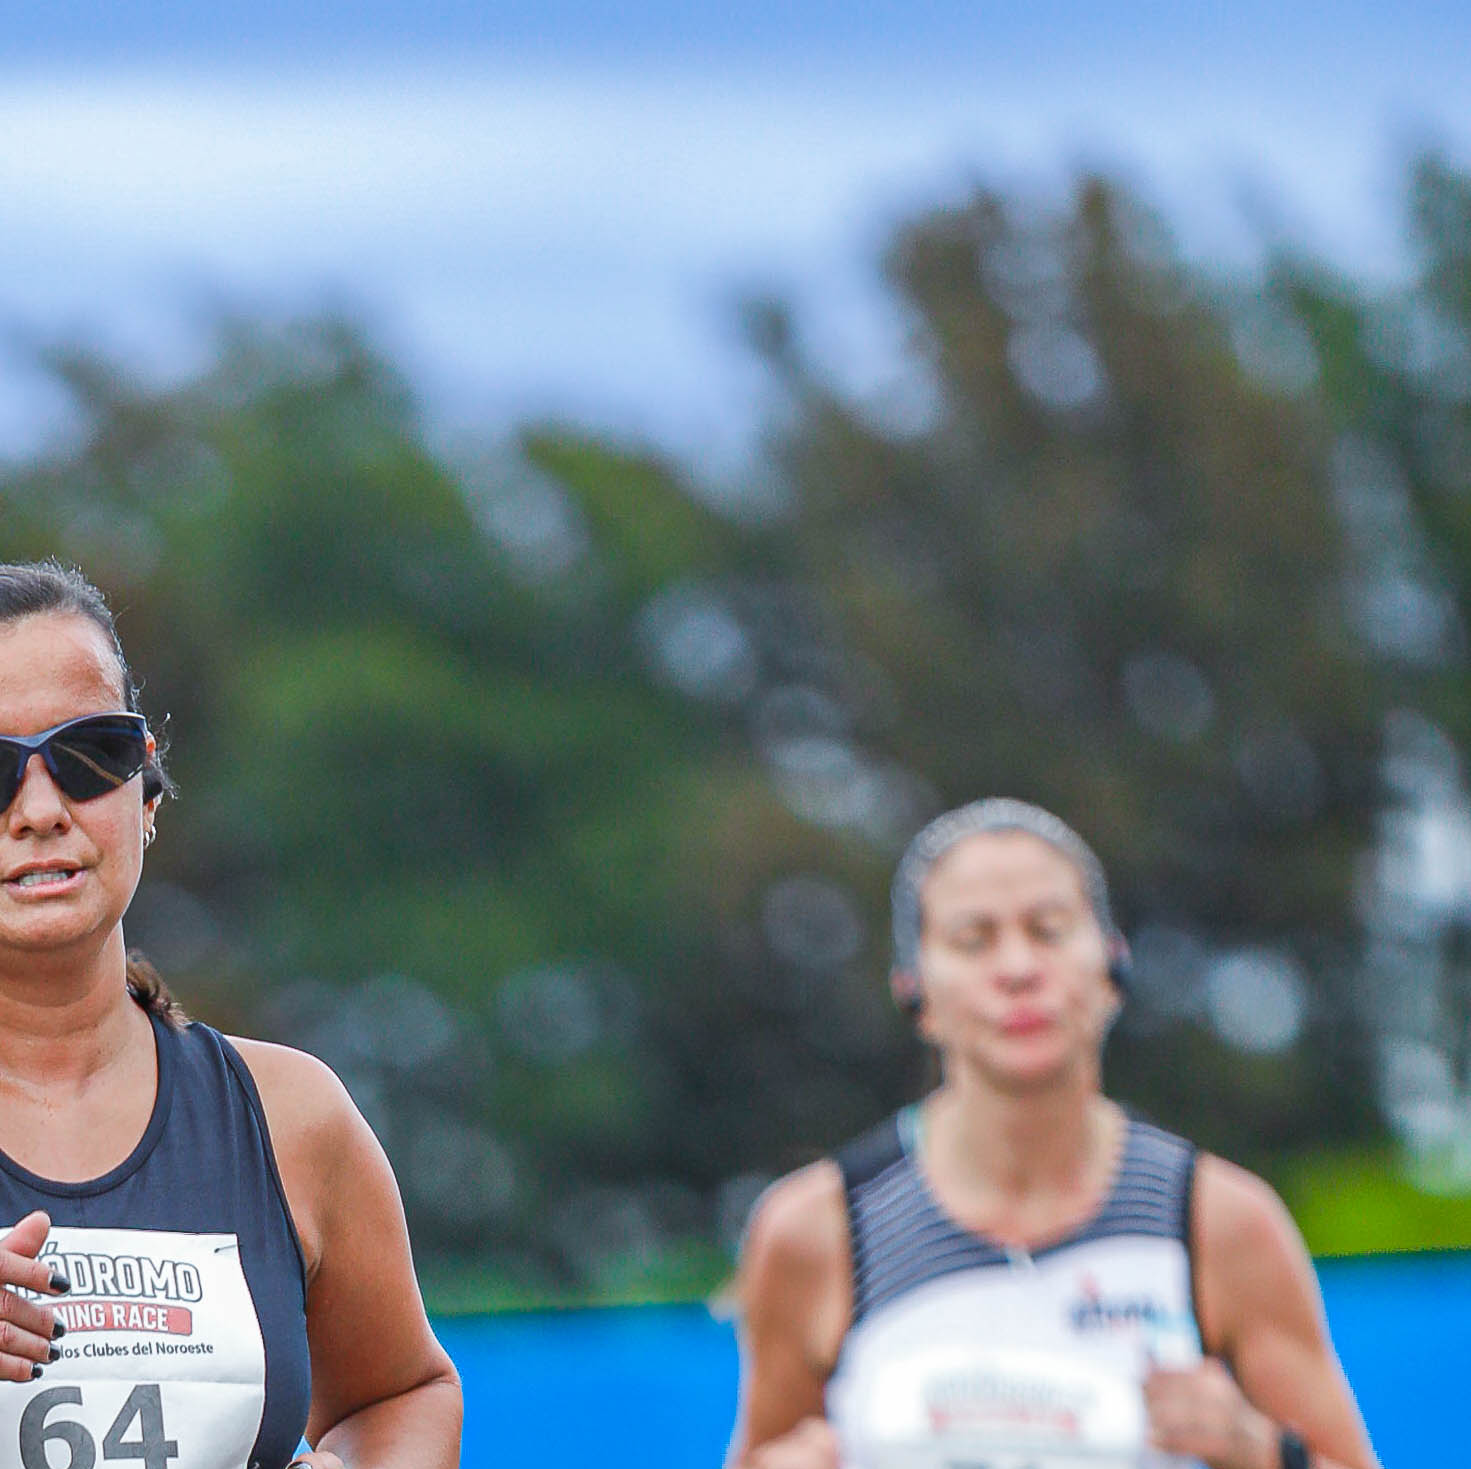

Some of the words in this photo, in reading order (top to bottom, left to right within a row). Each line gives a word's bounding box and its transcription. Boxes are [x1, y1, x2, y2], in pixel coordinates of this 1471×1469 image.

[8, 1241, 203, 1303] ÓDROMO
[112, 1305, 169, 1332] RACE
[61, 1345, 80, 1359] los
[83, 1343, 130, 1359] Clubes
[133, 1341, 154, 1356] del
[156, 1341, 215, 1355] Noroeste
